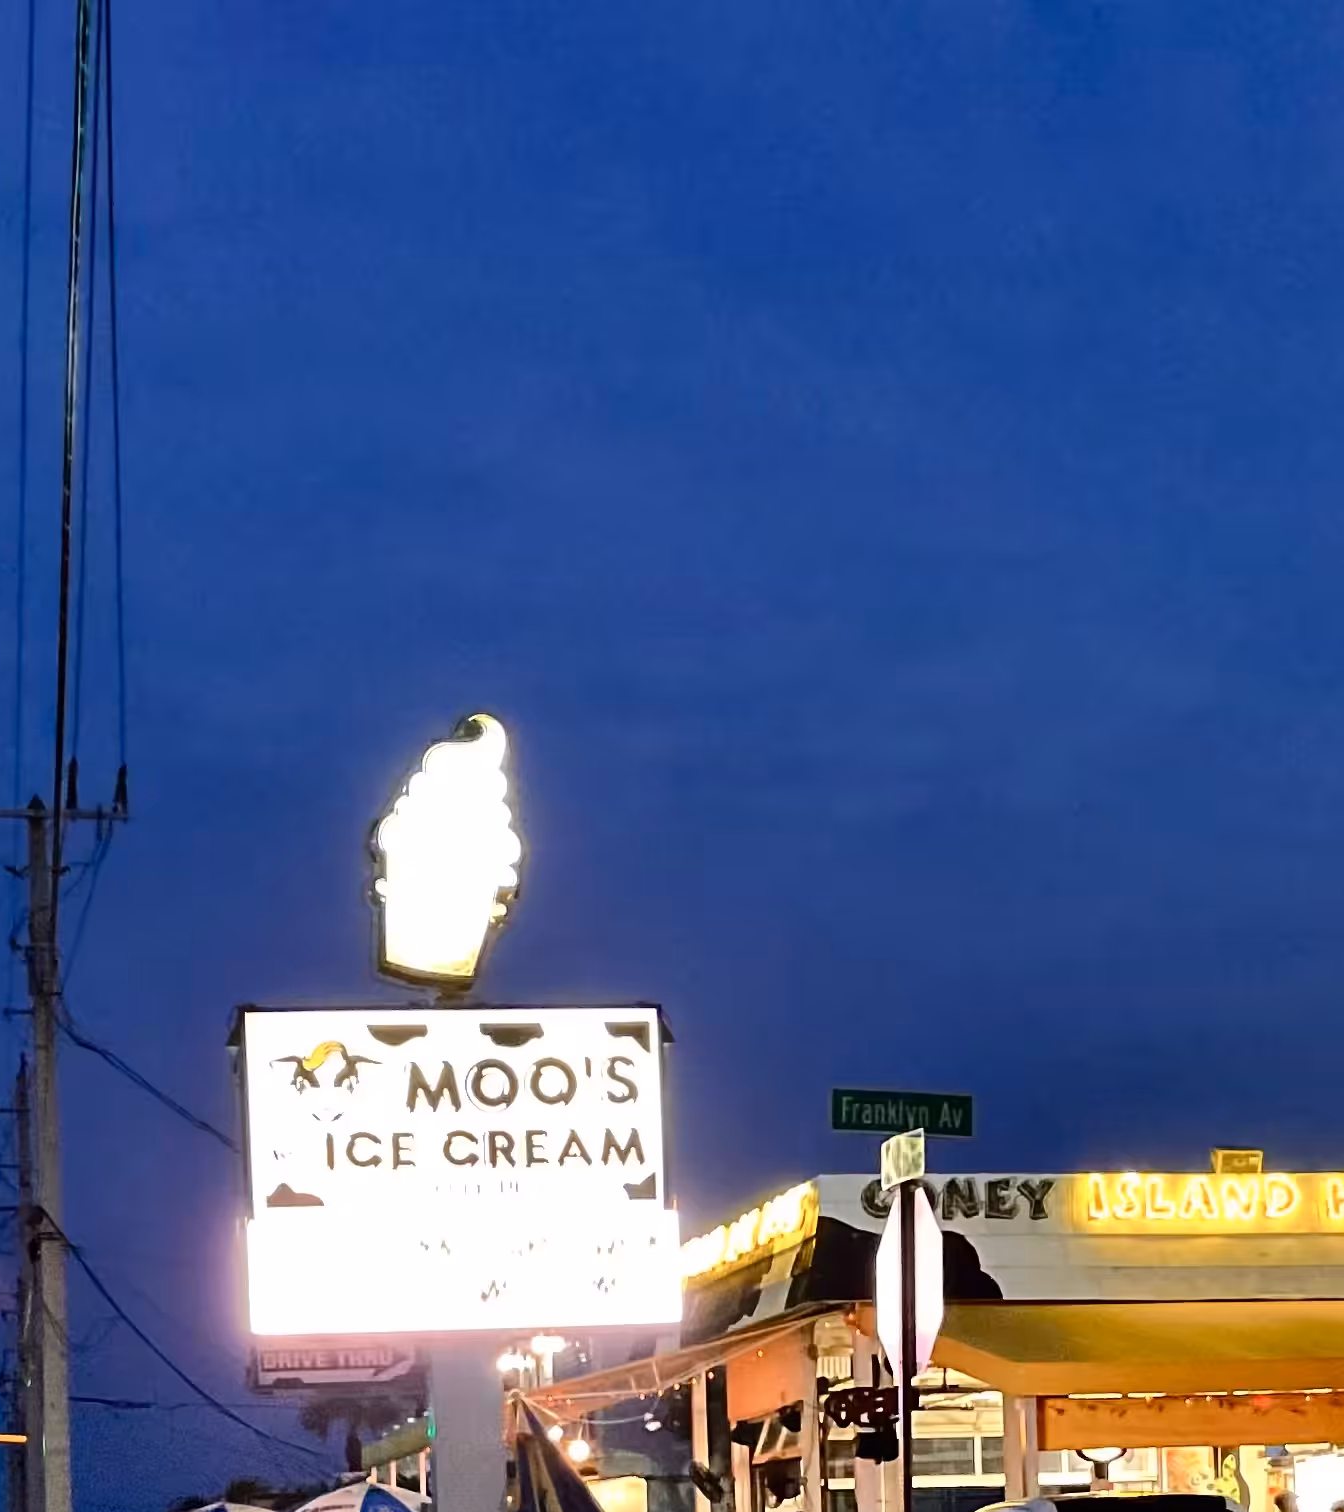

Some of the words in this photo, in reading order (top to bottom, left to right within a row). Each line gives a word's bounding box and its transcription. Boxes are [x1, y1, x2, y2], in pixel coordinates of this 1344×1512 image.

[404, 1056, 639, 1113] MOO'S
[841, 1096, 930, 1129] Franklyn
[938, 1102, 964, 1129] Av
[325, 1131, 416, 1170] ICE
[442, 1127, 646, 1169] CREAM
[1087, 1172, 1302, 1221] ISLAND
[261, 1350, 328, 1370] DRIVE
